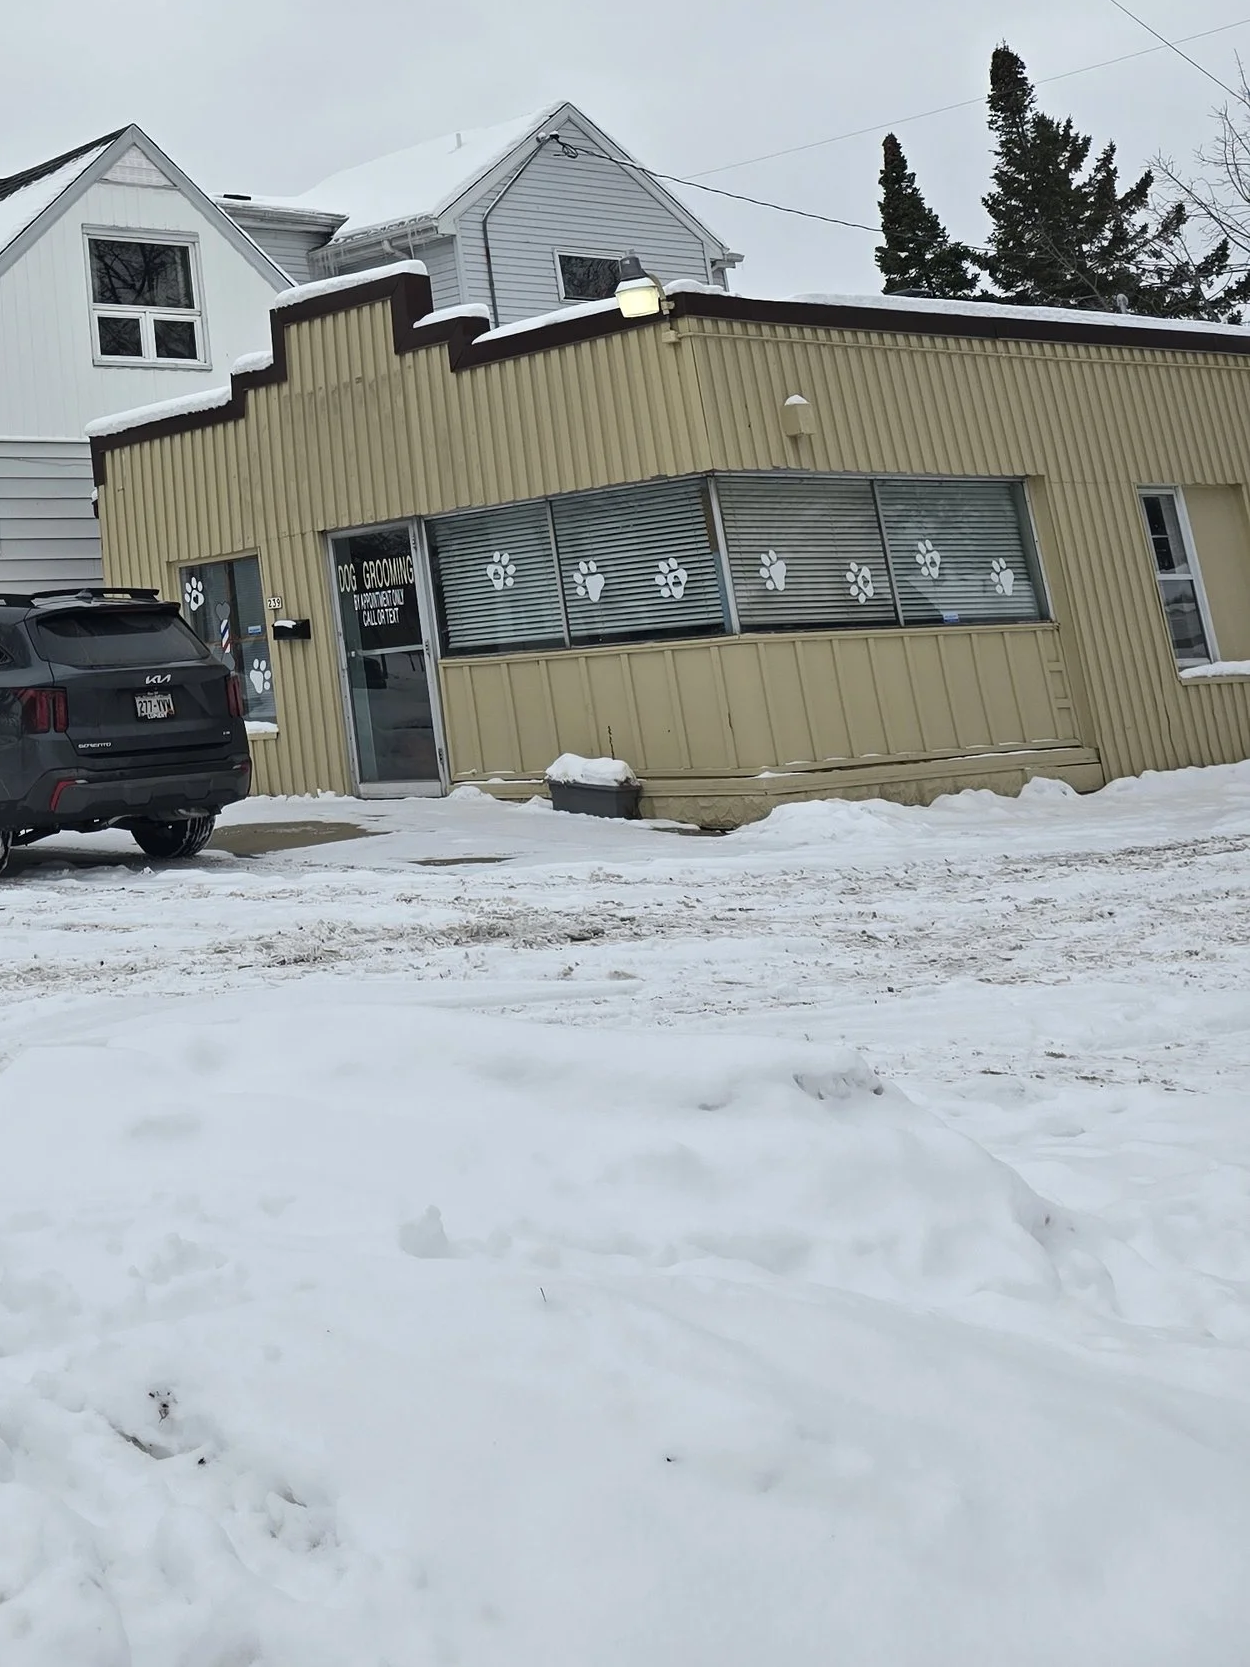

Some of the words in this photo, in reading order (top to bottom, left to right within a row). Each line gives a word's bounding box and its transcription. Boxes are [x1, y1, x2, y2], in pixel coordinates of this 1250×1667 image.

[338, 563, 357, 593] DOG
[362, 555, 414, 590] GROOMING
[268, 598, 281, 608] 239
[360, 590, 392, 610] APPOINTMENT
[362, 610, 378, 627] CALL
[377, 609, 386, 625] OR
[385, 608, 400, 624] TEXT
